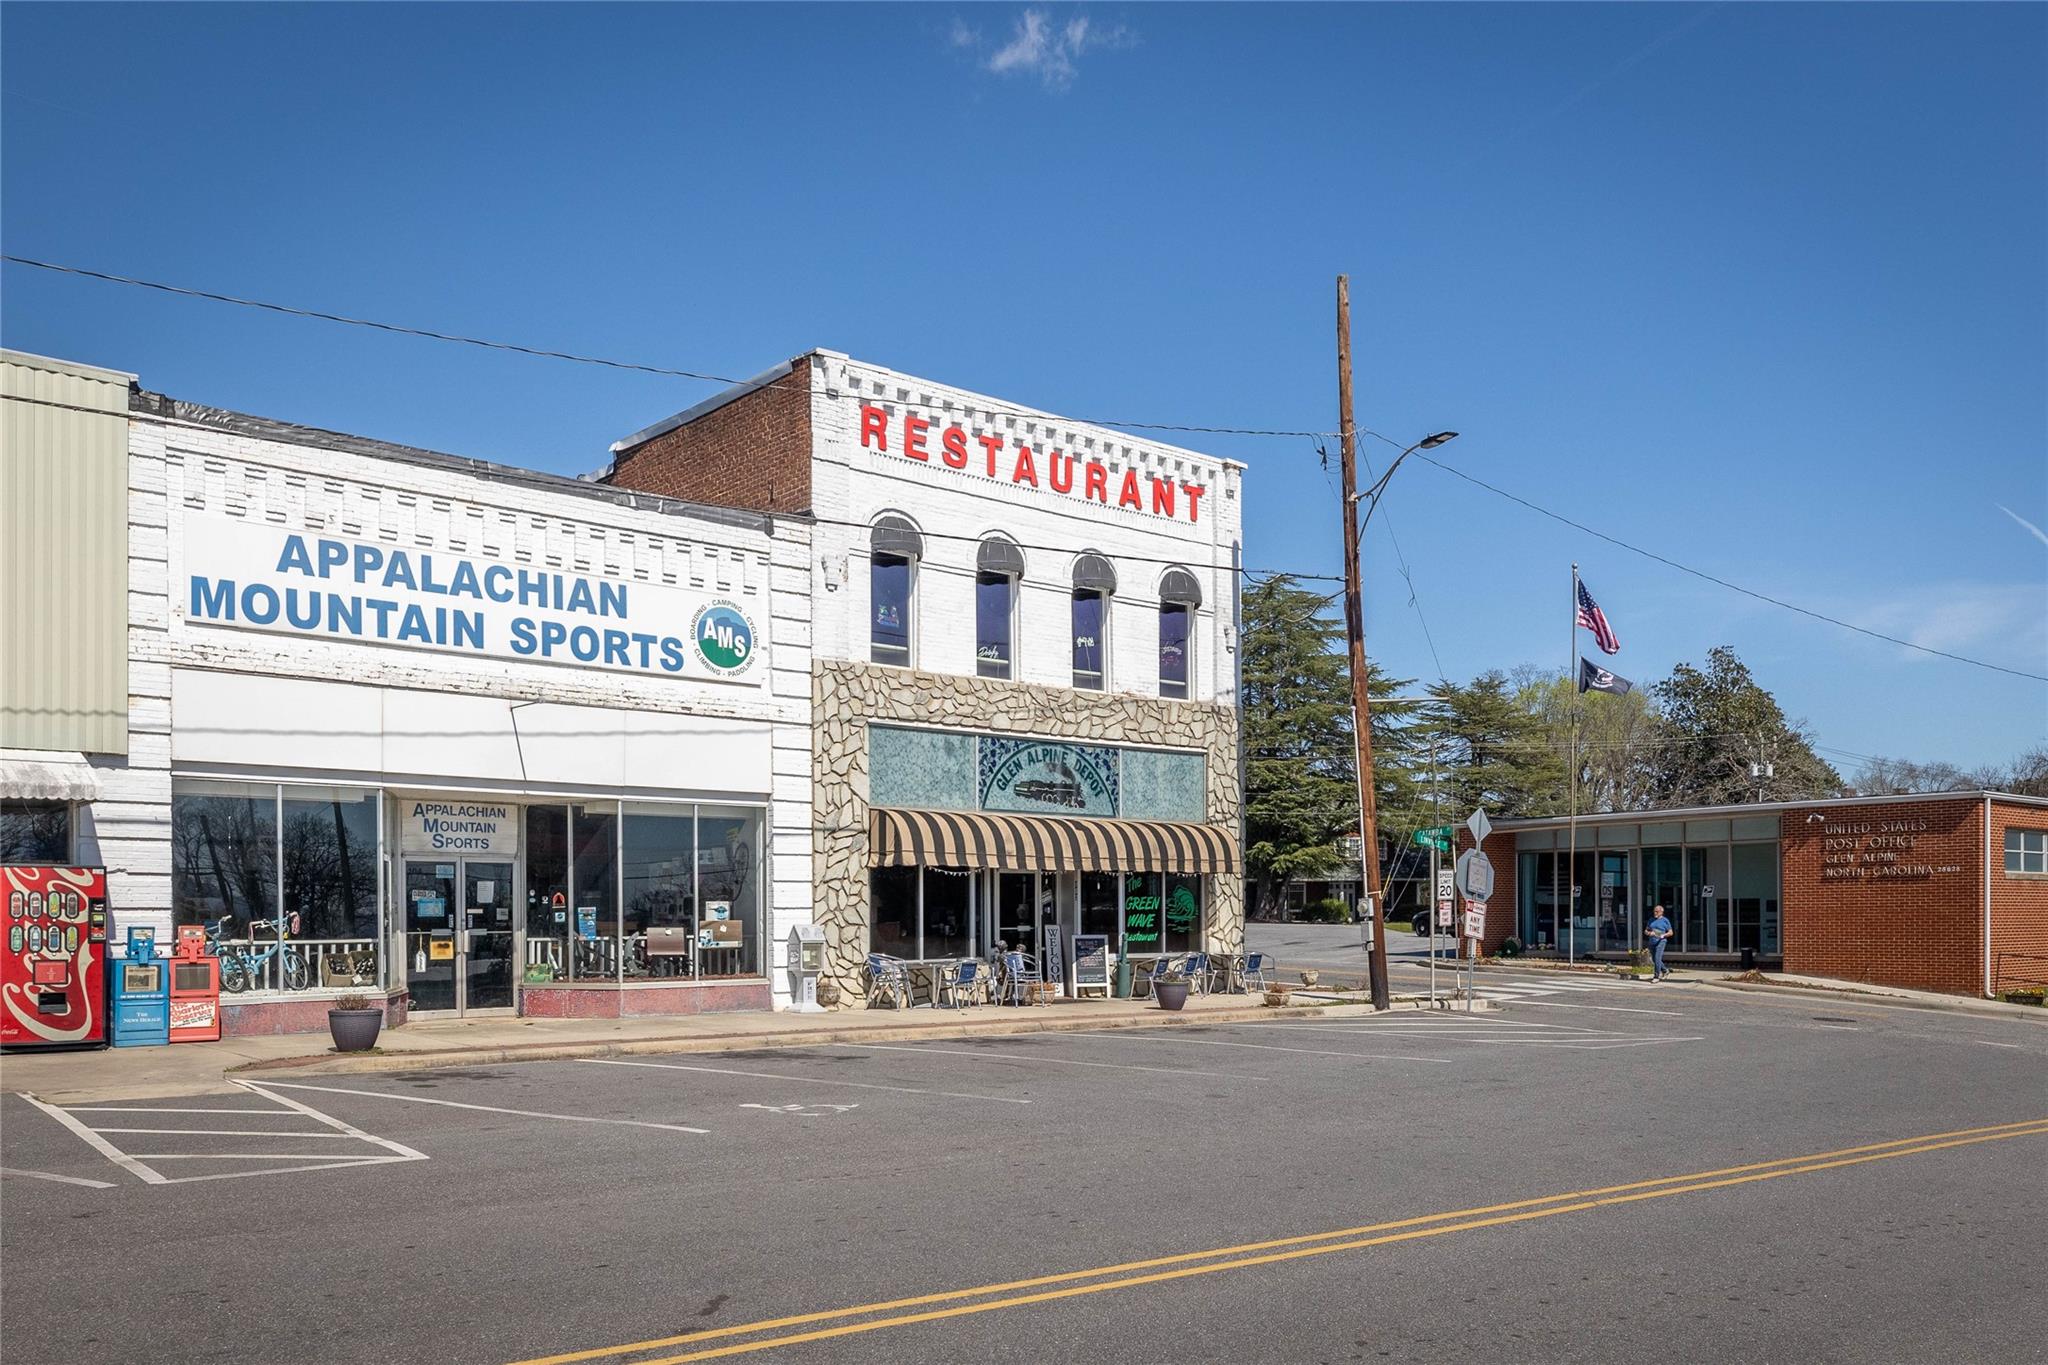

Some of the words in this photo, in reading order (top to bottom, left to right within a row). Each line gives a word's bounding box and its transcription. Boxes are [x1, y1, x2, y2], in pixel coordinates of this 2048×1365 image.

[861, 405, 1205, 522] RESTAURANT
[276, 534, 628, 619] APPALACHIAN
[711, 600, 743, 613] CAMPING
[190, 576, 485, 649] MOUNTAIN
[510, 617, 685, 672] SPORTS
[690, 604, 708, 640] BOARDING
[703, 617, 746, 658] AMS
[746, 616, 759, 649] CYCLING
[694, 648, 721, 676] CLIMBING
[727, 656, 756, 677] PADDLING
[996, 758, 1024, 791] GLEN
[1027, 748, 1069, 766] ALPINE
[1073, 758, 1105, 797] DEPOT
[412, 803, 506, 818] APPALACHIAN
[423, 818, 496, 833] MOUNTAIN
[1825, 822, 1871, 835] UNITED
[1880, 820, 1927, 833] STATES
[432, 833, 490, 849] SPORTS
[1825, 838, 1859, 850] POST
[1869, 834, 1918, 849] OFFICE
[1826, 852, 1854, 864] GLEN
[1862, 850, 1900, 863] ALPINE
[1826, 866, 1865, 878] NORTH
[1872, 864, 1934, 878] CAROLINA
[1440, 885, 1452, 896] 20
[1125, 896, 1160, 911] GREEN
[1127, 914, 1156, 928] WAVE
[1470, 915, 1480, 924] ANY
[1047, 928, 1061, 994] WELCOME
